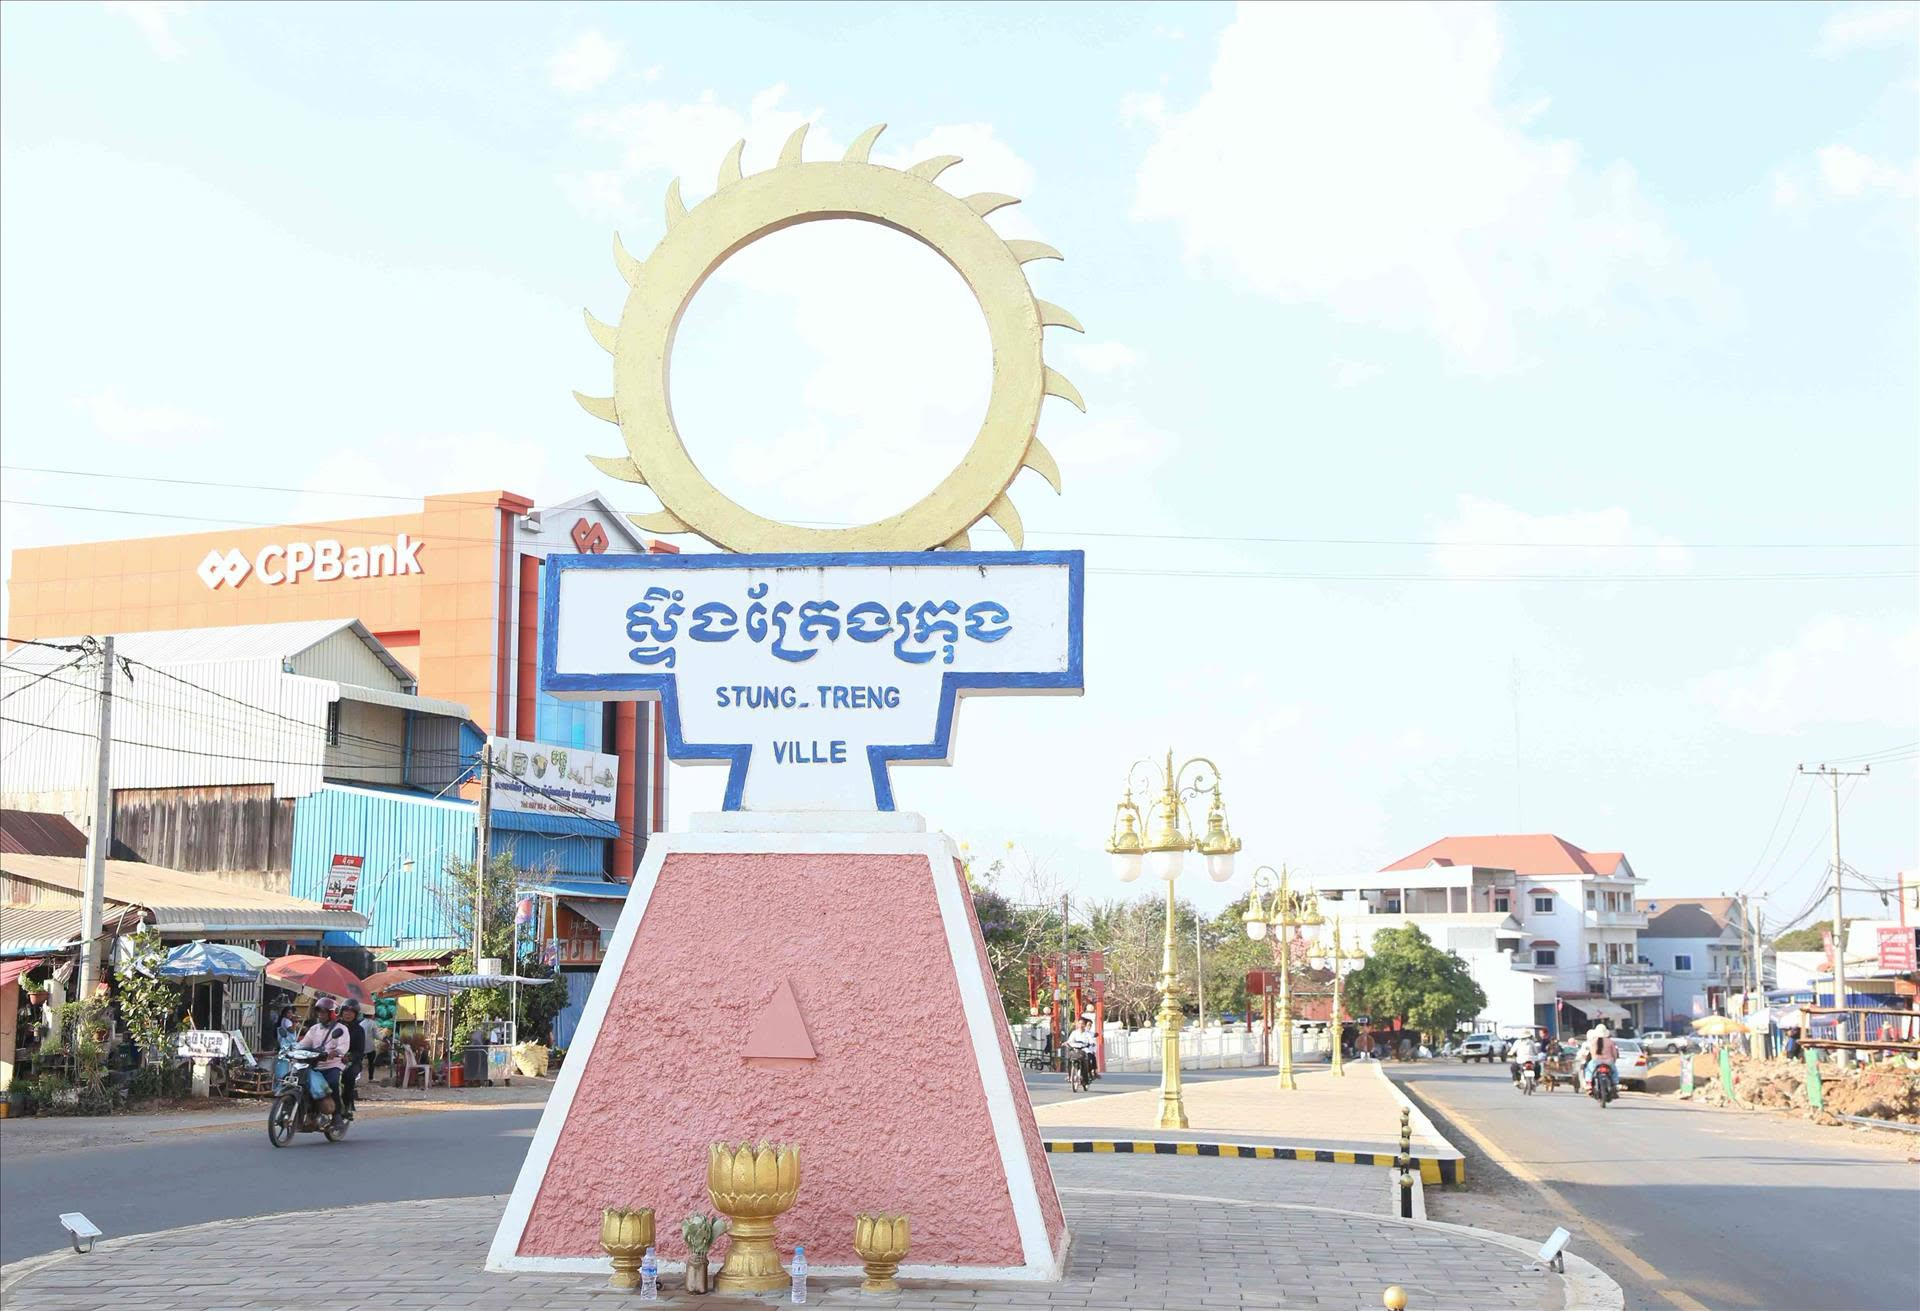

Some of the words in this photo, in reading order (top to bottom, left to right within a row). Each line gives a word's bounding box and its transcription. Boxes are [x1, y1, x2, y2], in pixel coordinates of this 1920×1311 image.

[255, 533, 425, 585] CPBank
[817, 686, 900, 709] TRENG
[773, 740, 847, 764] VILLE
